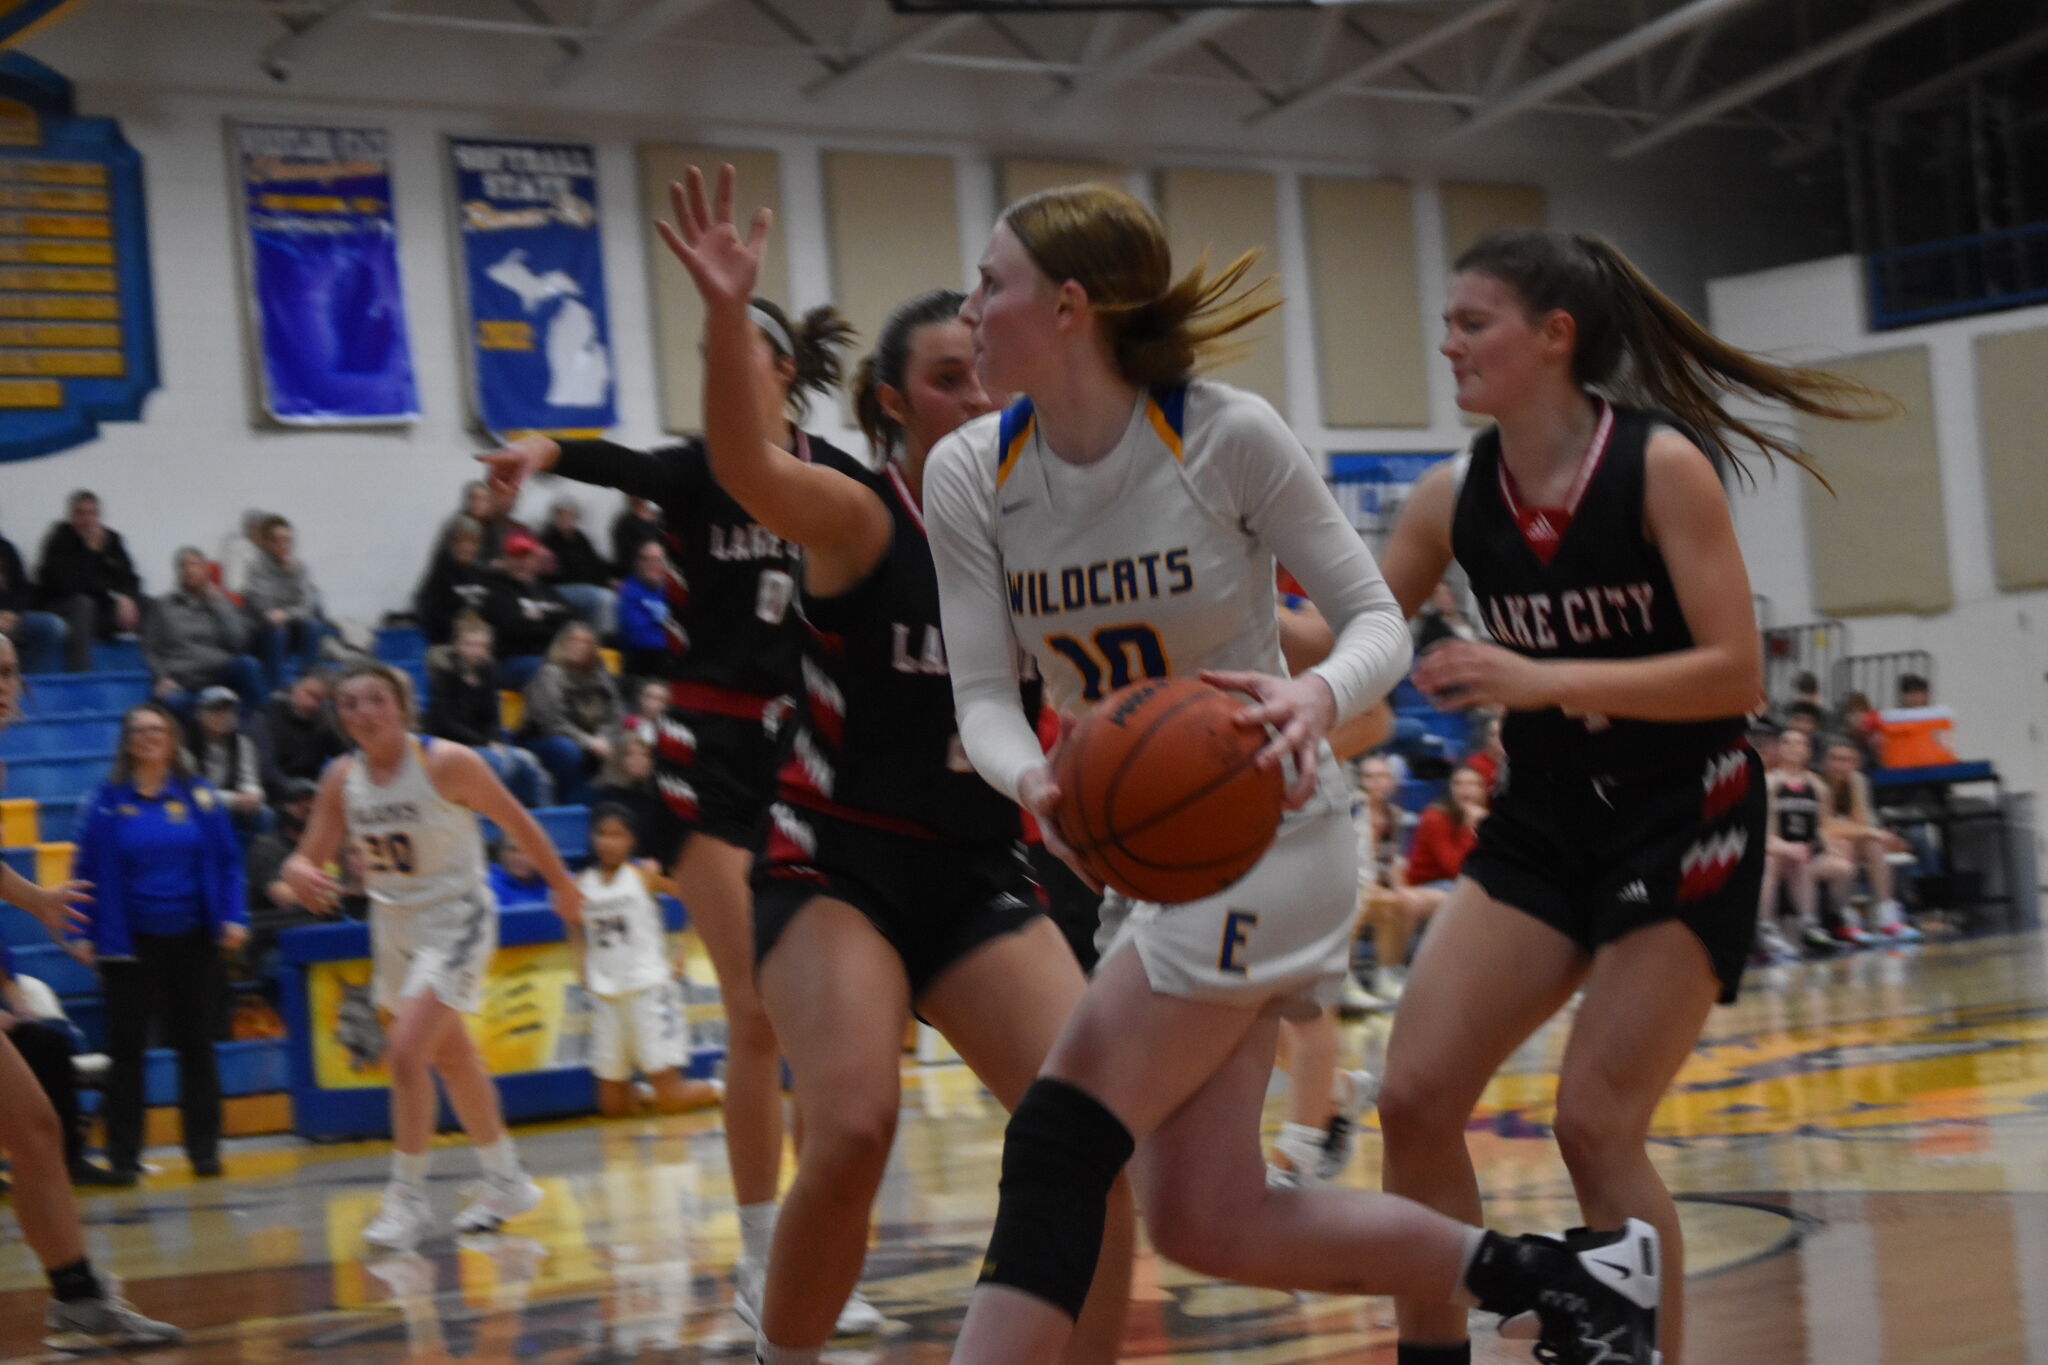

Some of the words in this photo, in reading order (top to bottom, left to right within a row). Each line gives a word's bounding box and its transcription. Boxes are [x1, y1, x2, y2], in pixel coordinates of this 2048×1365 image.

[1007, 547, 1194, 617] WILDCATS
[1561, 581, 1654, 645] CITY
[1043, 622, 1173, 703] 10
[1217, 908, 1261, 980] E
